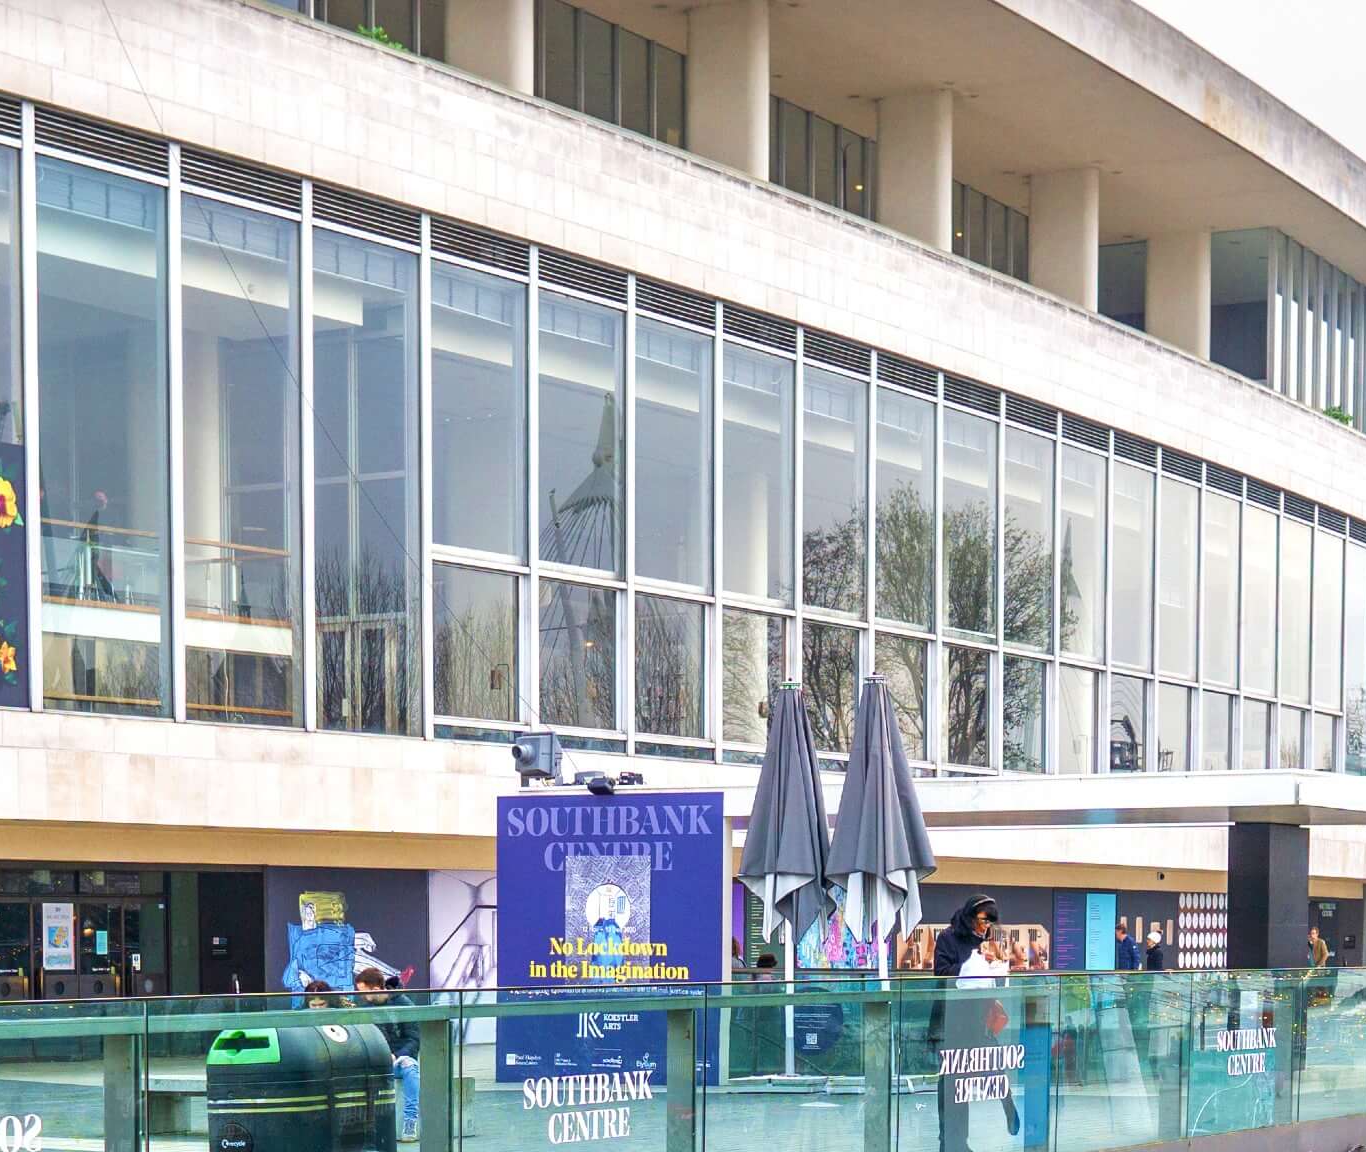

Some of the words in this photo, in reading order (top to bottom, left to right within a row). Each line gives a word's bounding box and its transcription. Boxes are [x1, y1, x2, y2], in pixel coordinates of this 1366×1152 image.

[507, 805, 713, 837] SOUTHBANK
[544, 842, 673, 871] CENTRE
[550, 937, 572, 955] No
[577, 937, 667, 956] Lockdown
[529, 961, 547, 978] in
[551, 960, 578, 978] the
[581, 960, 689, 983] Imagination
[603, 1022, 621, 1030] ARTS
[1216, 1027, 1277, 1052] SOUTHBANK
[1227, 1052, 1266, 1076] CENTRE
[523, 1070, 652, 1110] SOUTHBANK
[548, 1107, 630, 1144] CENTRE
